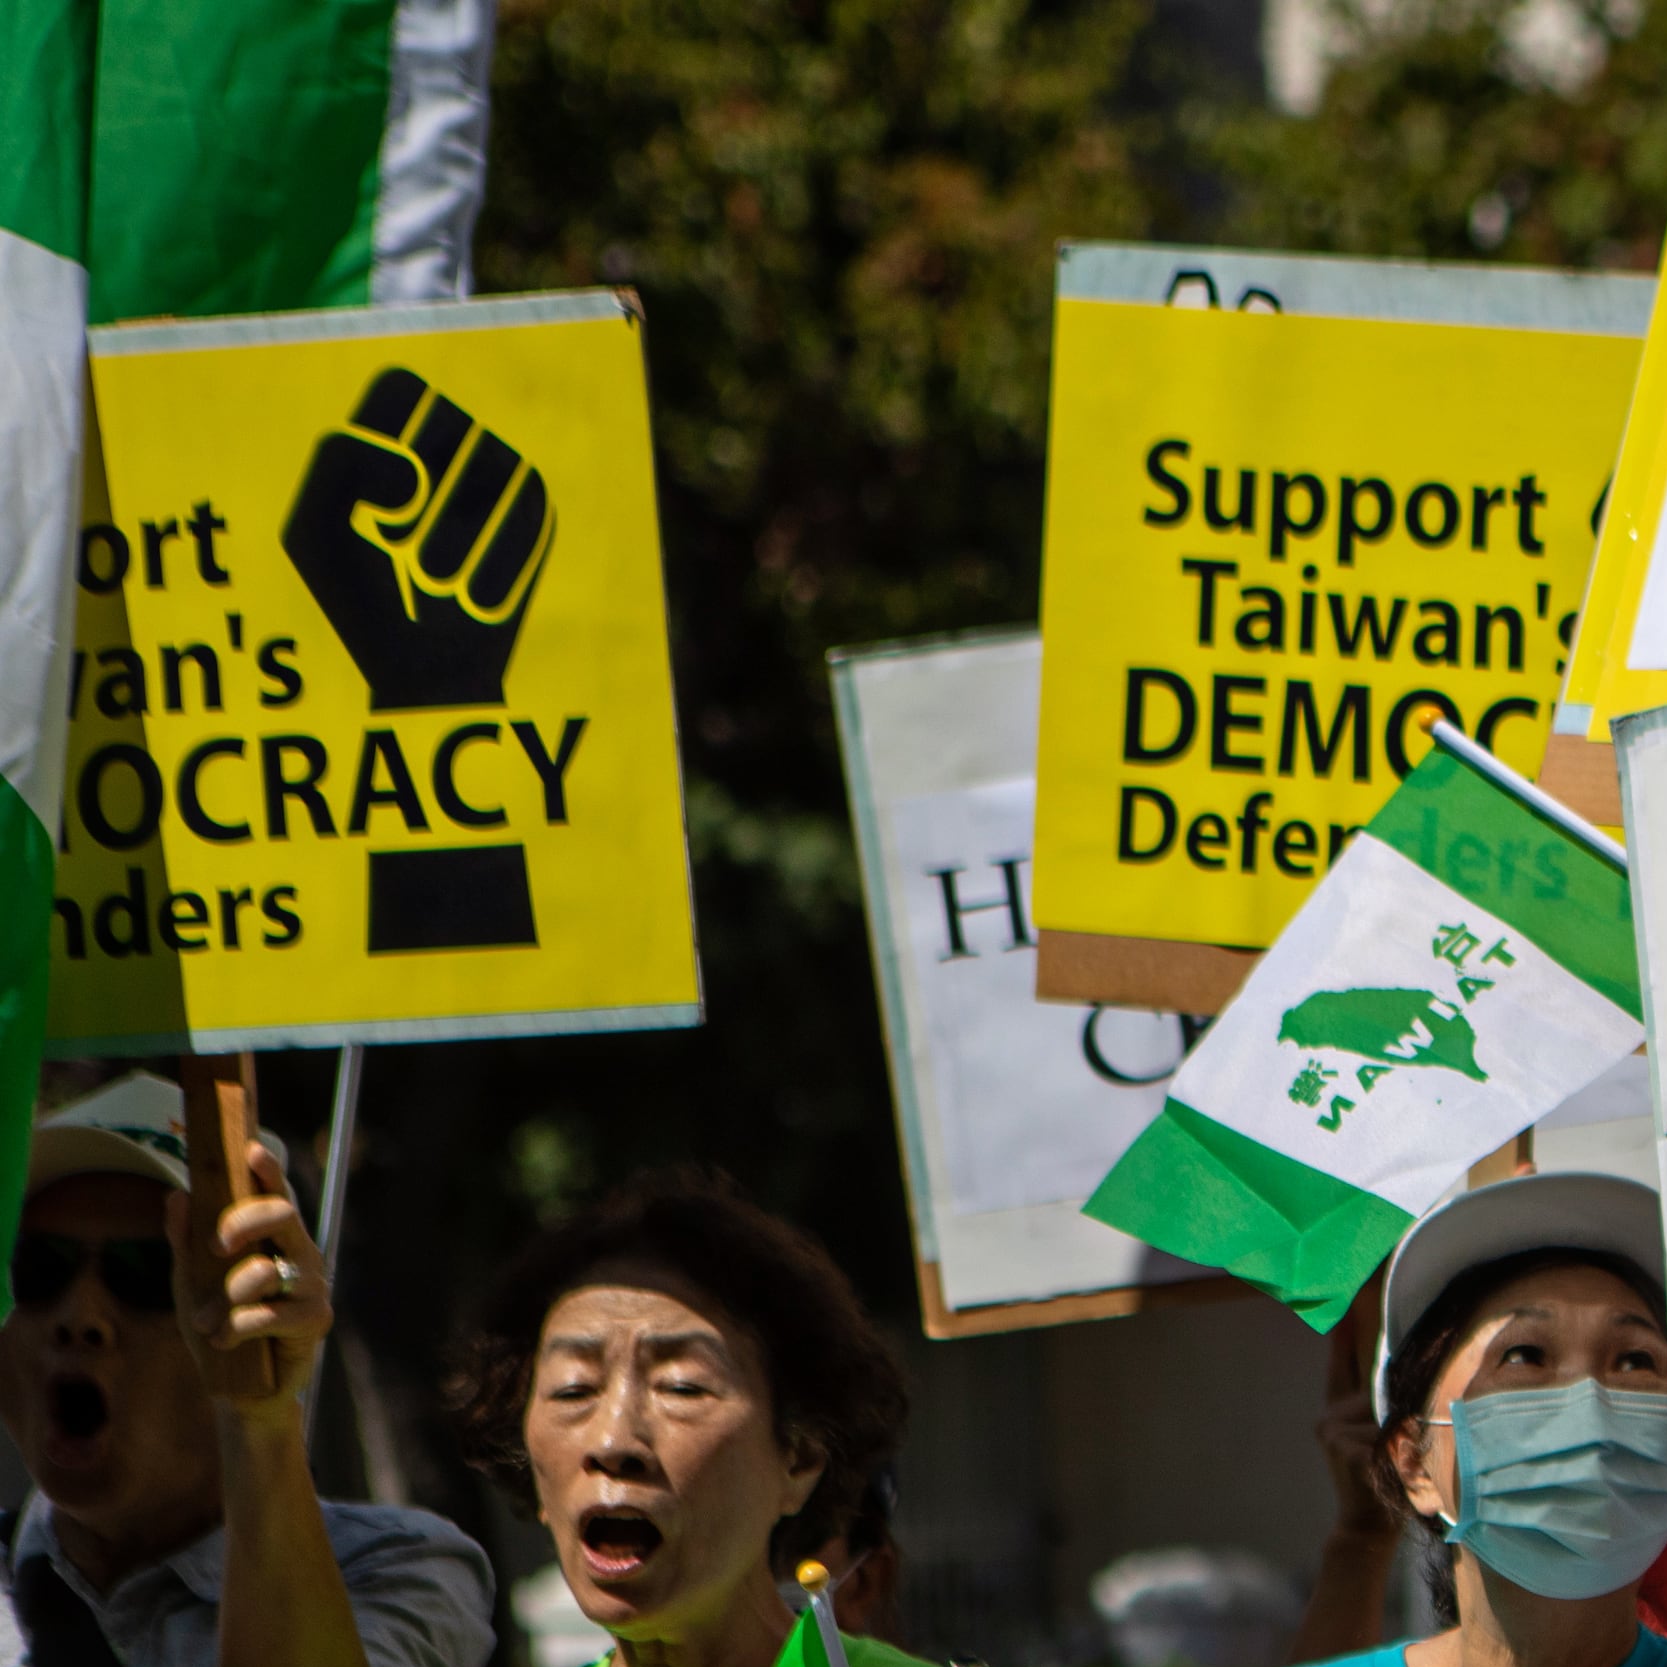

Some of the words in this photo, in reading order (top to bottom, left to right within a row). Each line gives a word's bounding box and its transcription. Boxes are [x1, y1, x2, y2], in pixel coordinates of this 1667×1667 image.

[1143, 438, 1548, 567] Support
[67, 613, 303, 721] an's
[1121, 667, 1557, 786] DEMOC
[57, 716, 589, 852] OCRACY
[52, 867, 303, 960] nders
